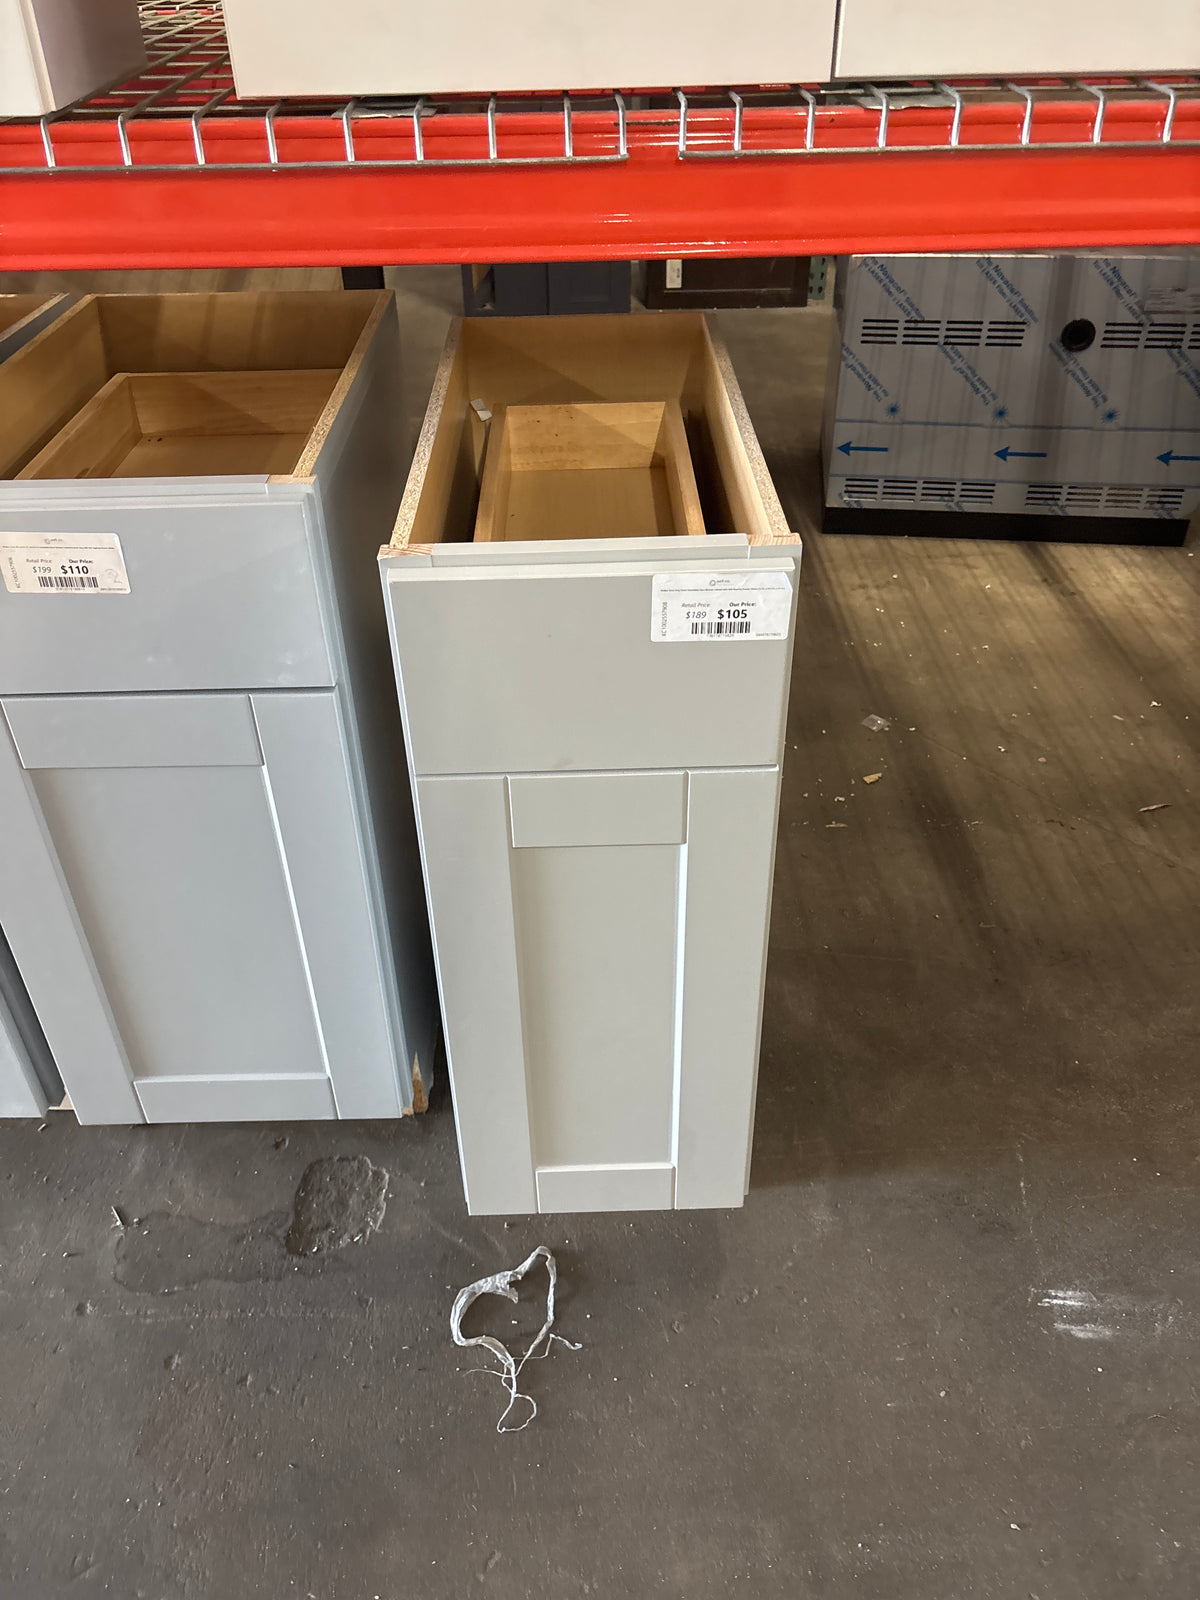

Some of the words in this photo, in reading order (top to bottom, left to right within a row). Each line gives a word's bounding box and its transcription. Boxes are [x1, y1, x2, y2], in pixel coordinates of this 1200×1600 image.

[32, 566, 52, 574] $199
[60, 565, 89, 574] $110
[686, 611, 706, 619] $189
[717, 609, 748, 620] $105
